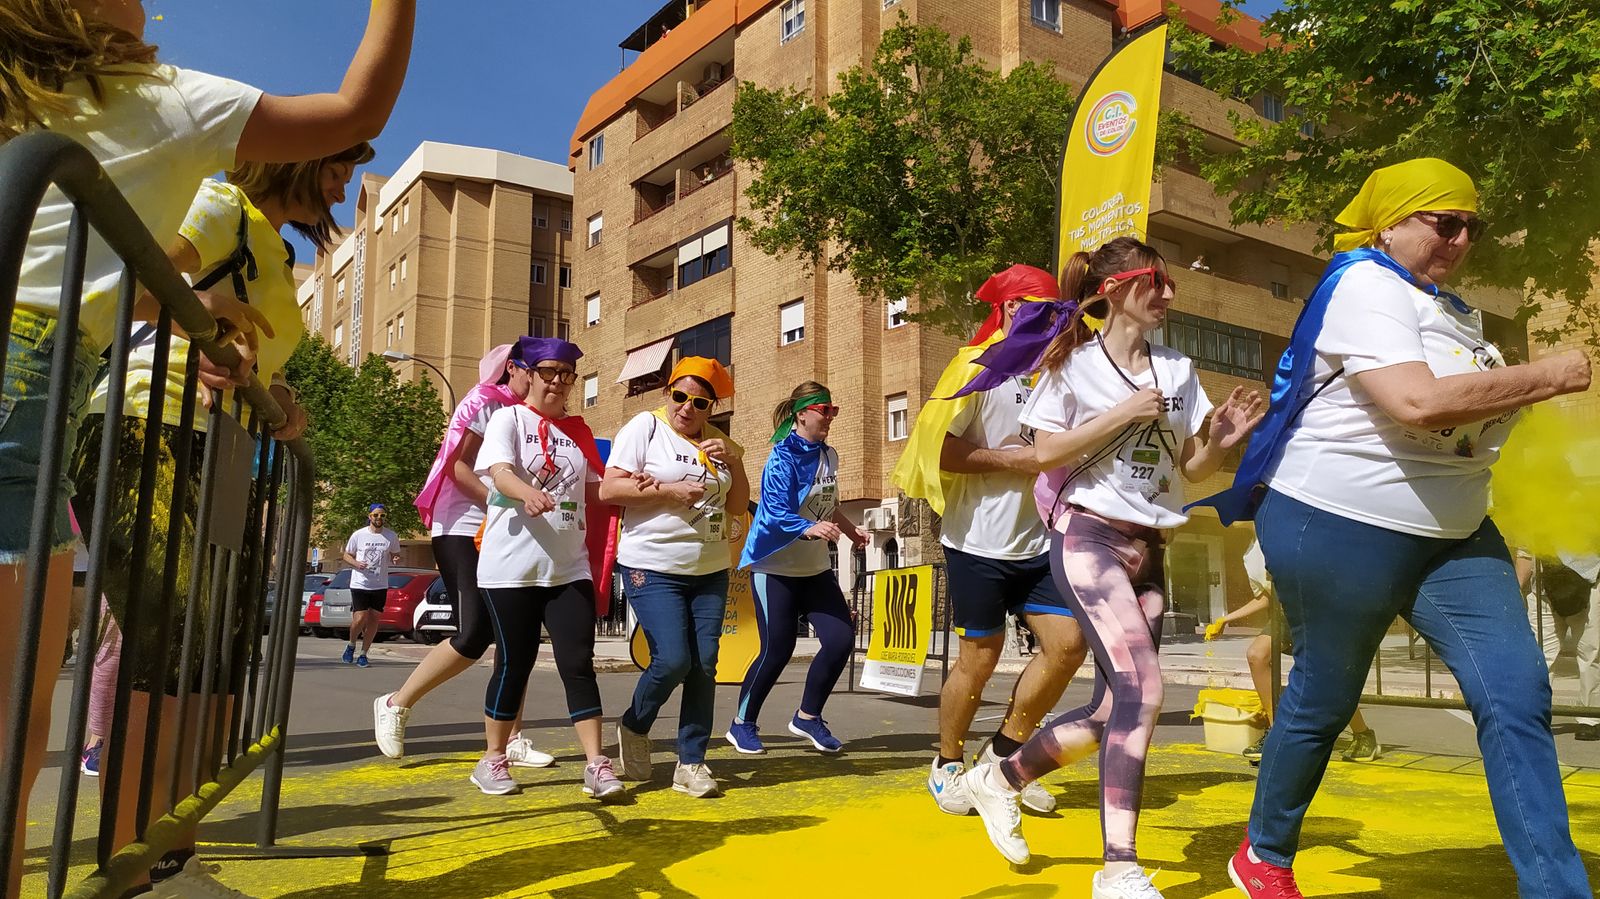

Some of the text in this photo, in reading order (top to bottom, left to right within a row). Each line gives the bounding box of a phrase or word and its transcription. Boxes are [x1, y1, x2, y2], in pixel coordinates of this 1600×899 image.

[1097, 115, 1128, 131] EVENTOS
[1082, 192, 1124, 222] COLOREA
[1069, 226, 1086, 241] TUS
[1162, 396, 1184, 412] ERO
[526, 434, 578, 448] BE HERO
[676, 454, 689, 463] BE
[692, 458, 697, 466] A
[1131, 465, 1155, 480] 227
[561, 512, 575, 522] 184
[725, 610, 738, 621] DA
